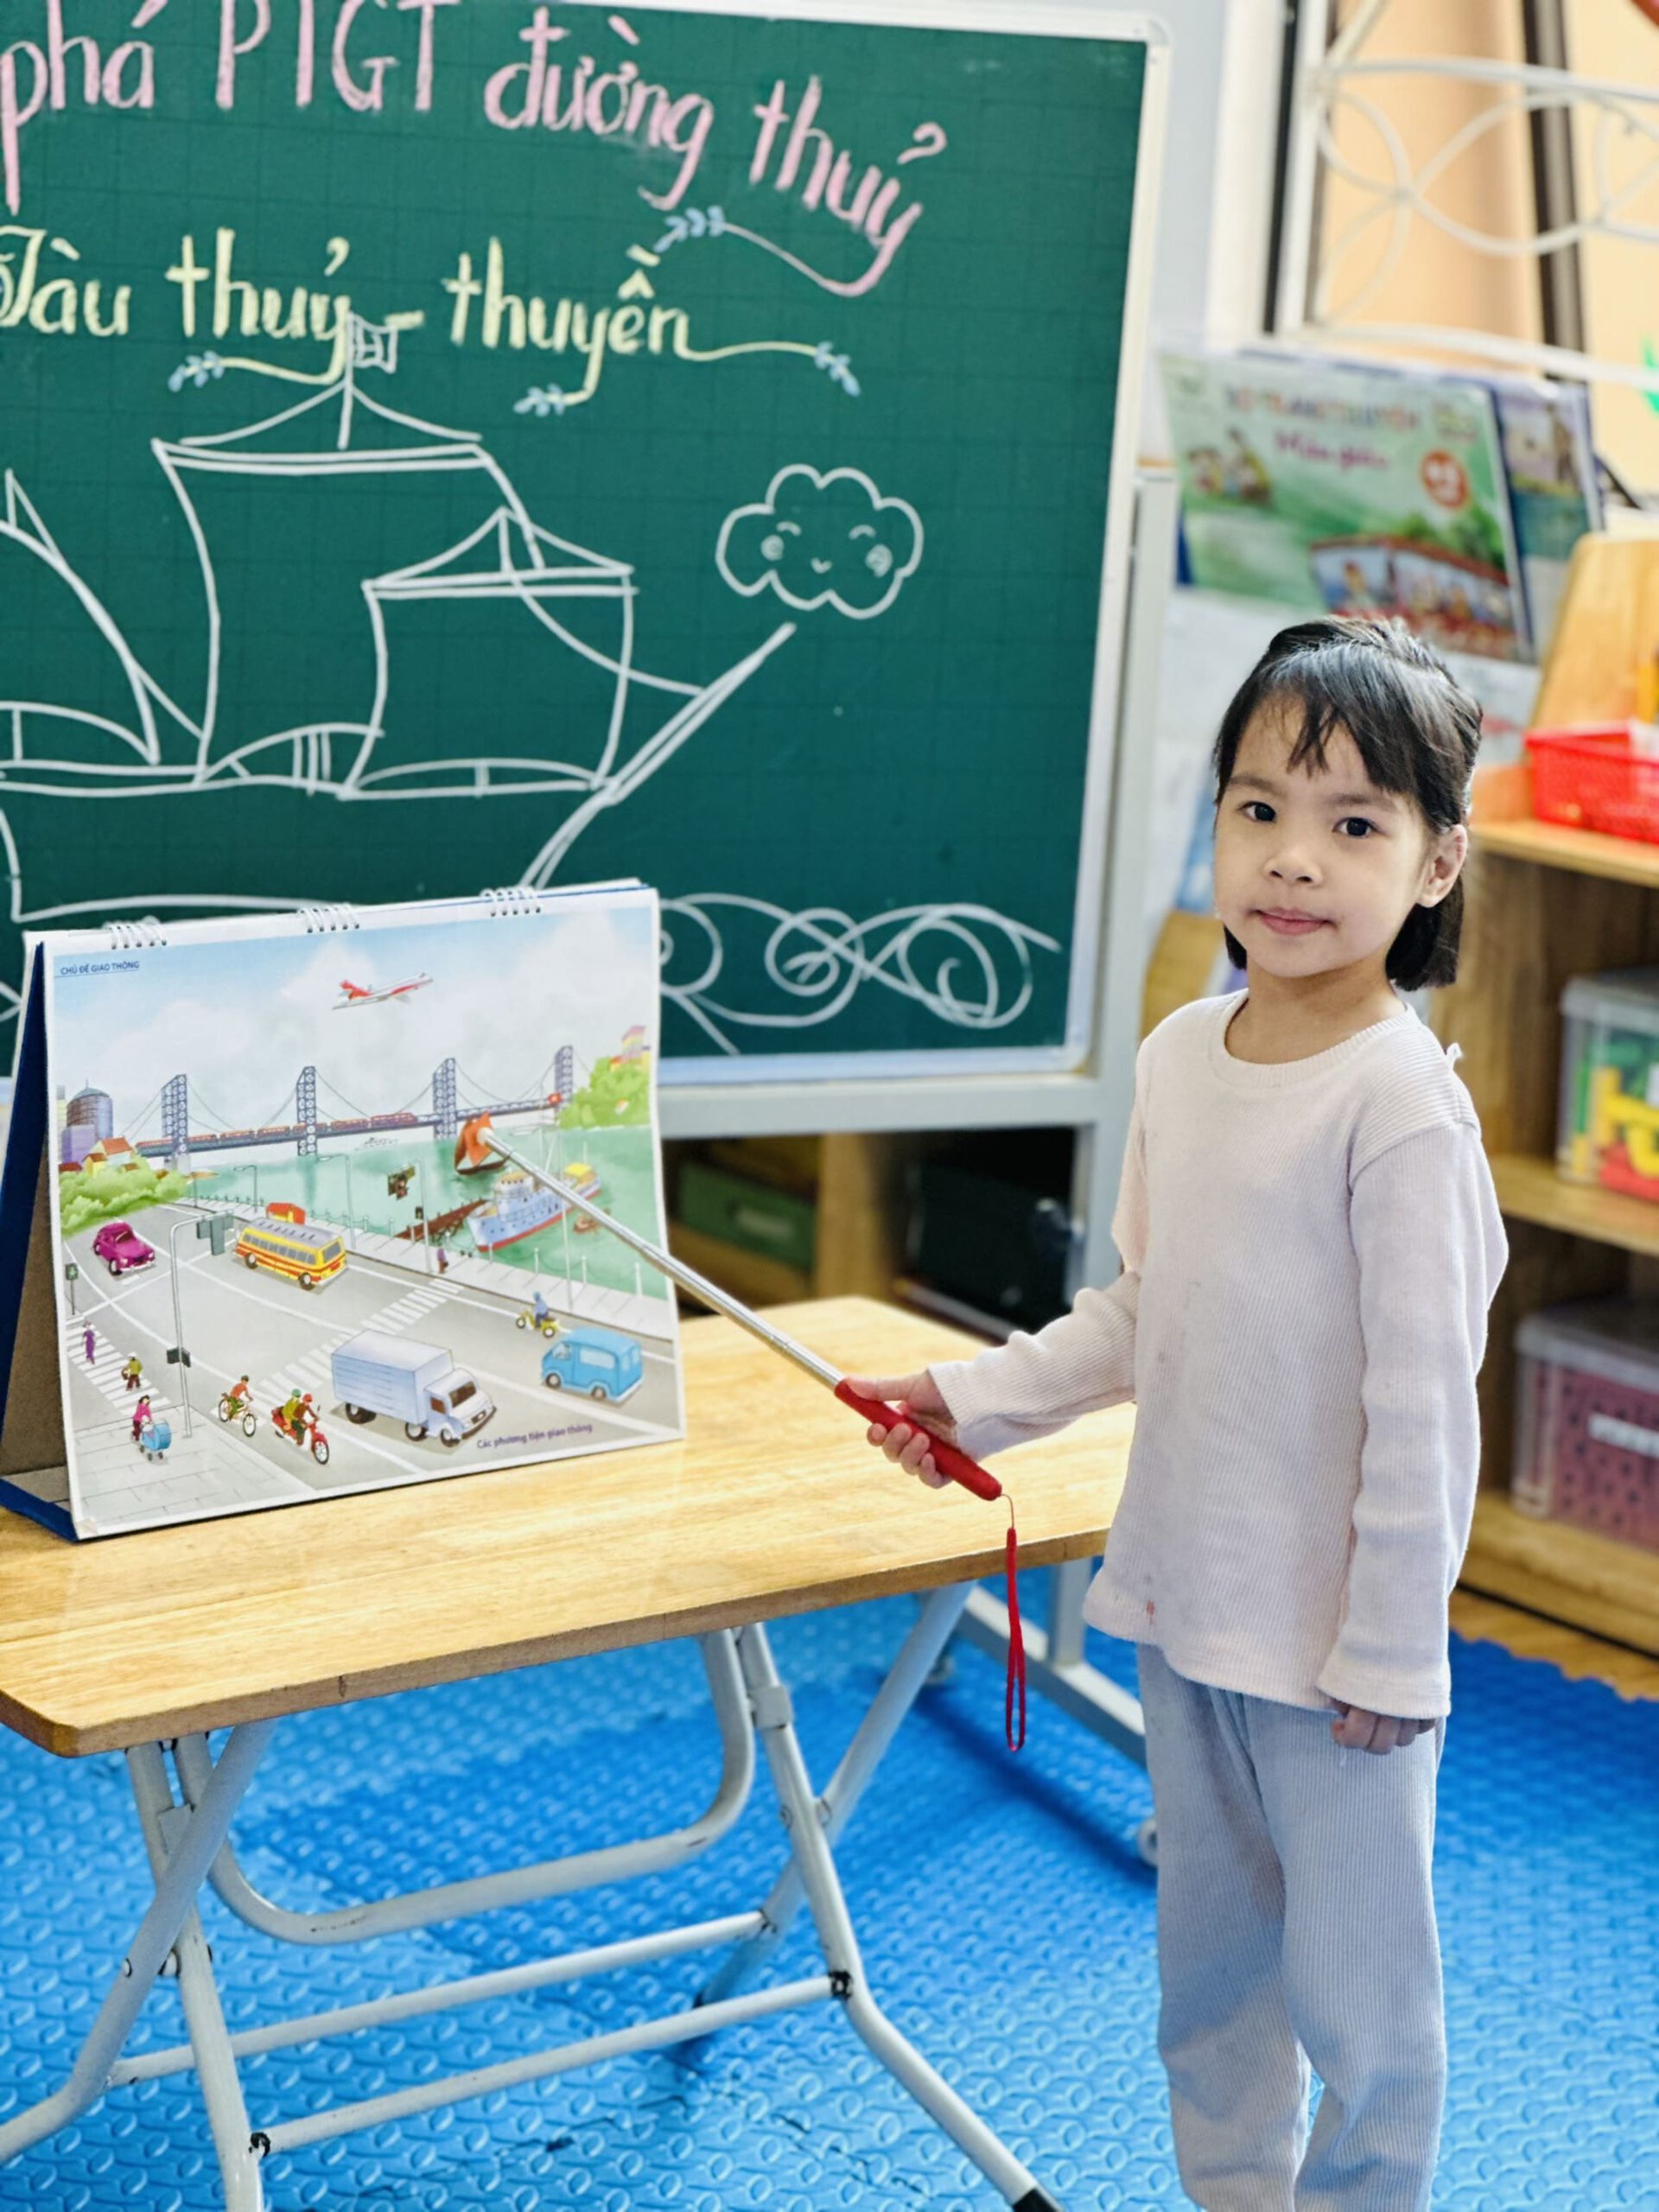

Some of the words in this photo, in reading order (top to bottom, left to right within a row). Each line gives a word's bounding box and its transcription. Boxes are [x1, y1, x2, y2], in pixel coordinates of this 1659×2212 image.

[0, 0, 168, 216] phá
[484, 7, 714, 211] đường
[0, 226, 131, 337] Tàu
[442, 236, 717, 404] thuyền
[91, 963, 111, 973] GIAO
[111, 960, 139, 969] THÔNG
[547, 1428, 566, 1440] giao
